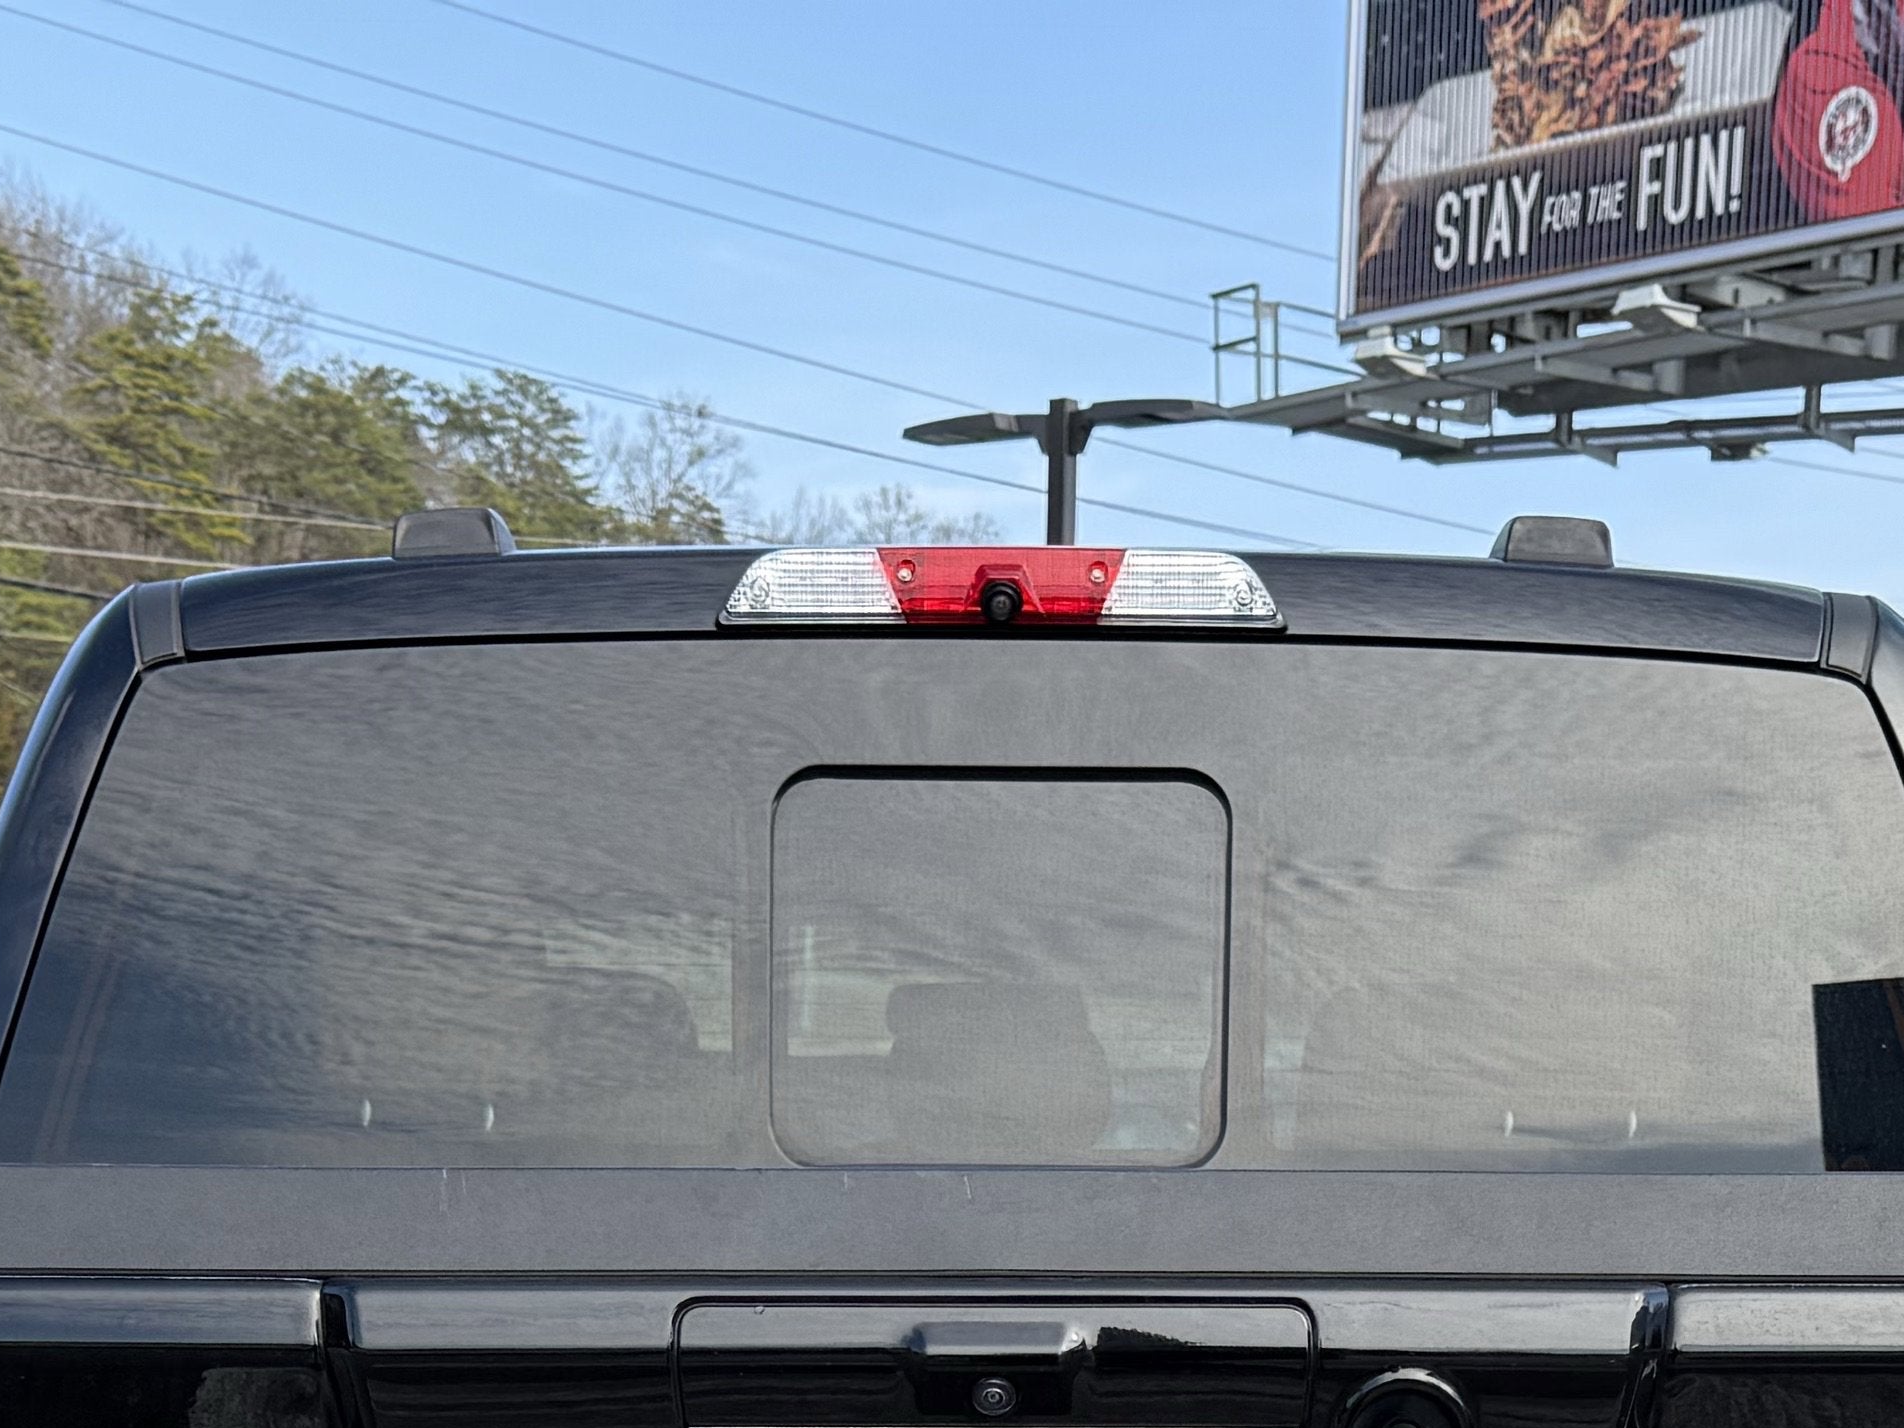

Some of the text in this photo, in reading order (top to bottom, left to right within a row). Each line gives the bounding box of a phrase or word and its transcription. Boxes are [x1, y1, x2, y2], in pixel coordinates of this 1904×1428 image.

[1433, 170, 1543, 272] STAY
[1541, 190, 1582, 234] FOR
[1586, 180, 1628, 226] THE
[1636, 126, 1746, 232] FUN!
